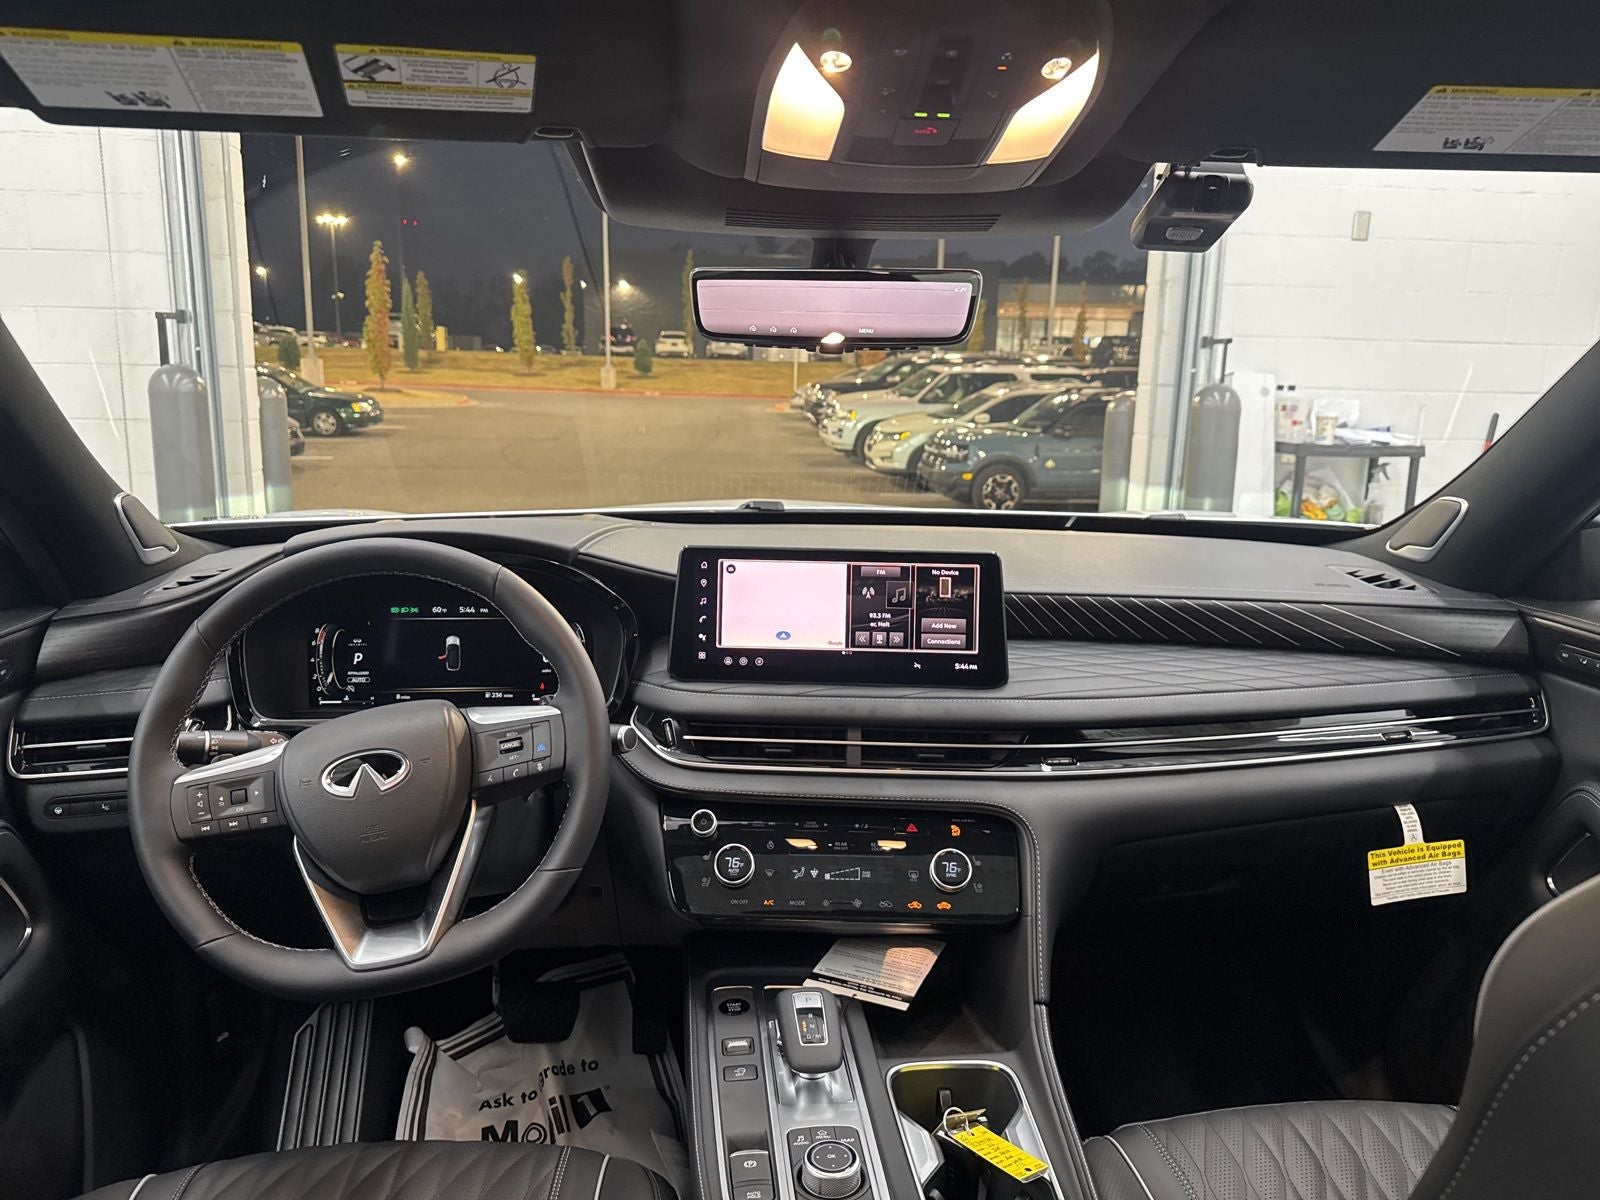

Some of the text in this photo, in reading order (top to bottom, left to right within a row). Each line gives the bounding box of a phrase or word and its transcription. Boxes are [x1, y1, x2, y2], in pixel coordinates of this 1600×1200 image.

[353, 652, 364, 665] P
[1388, 848, 1415, 856] Vehicle
[1426, 842, 1462, 851] Equipped
[1390, 853, 1426, 864] Advanced
[479, 1092, 514, 1111] Ask
[521, 1090, 538, 1104] to
[581, 1059, 599, 1072] to
[482, 1094, 571, 1144] Moil
